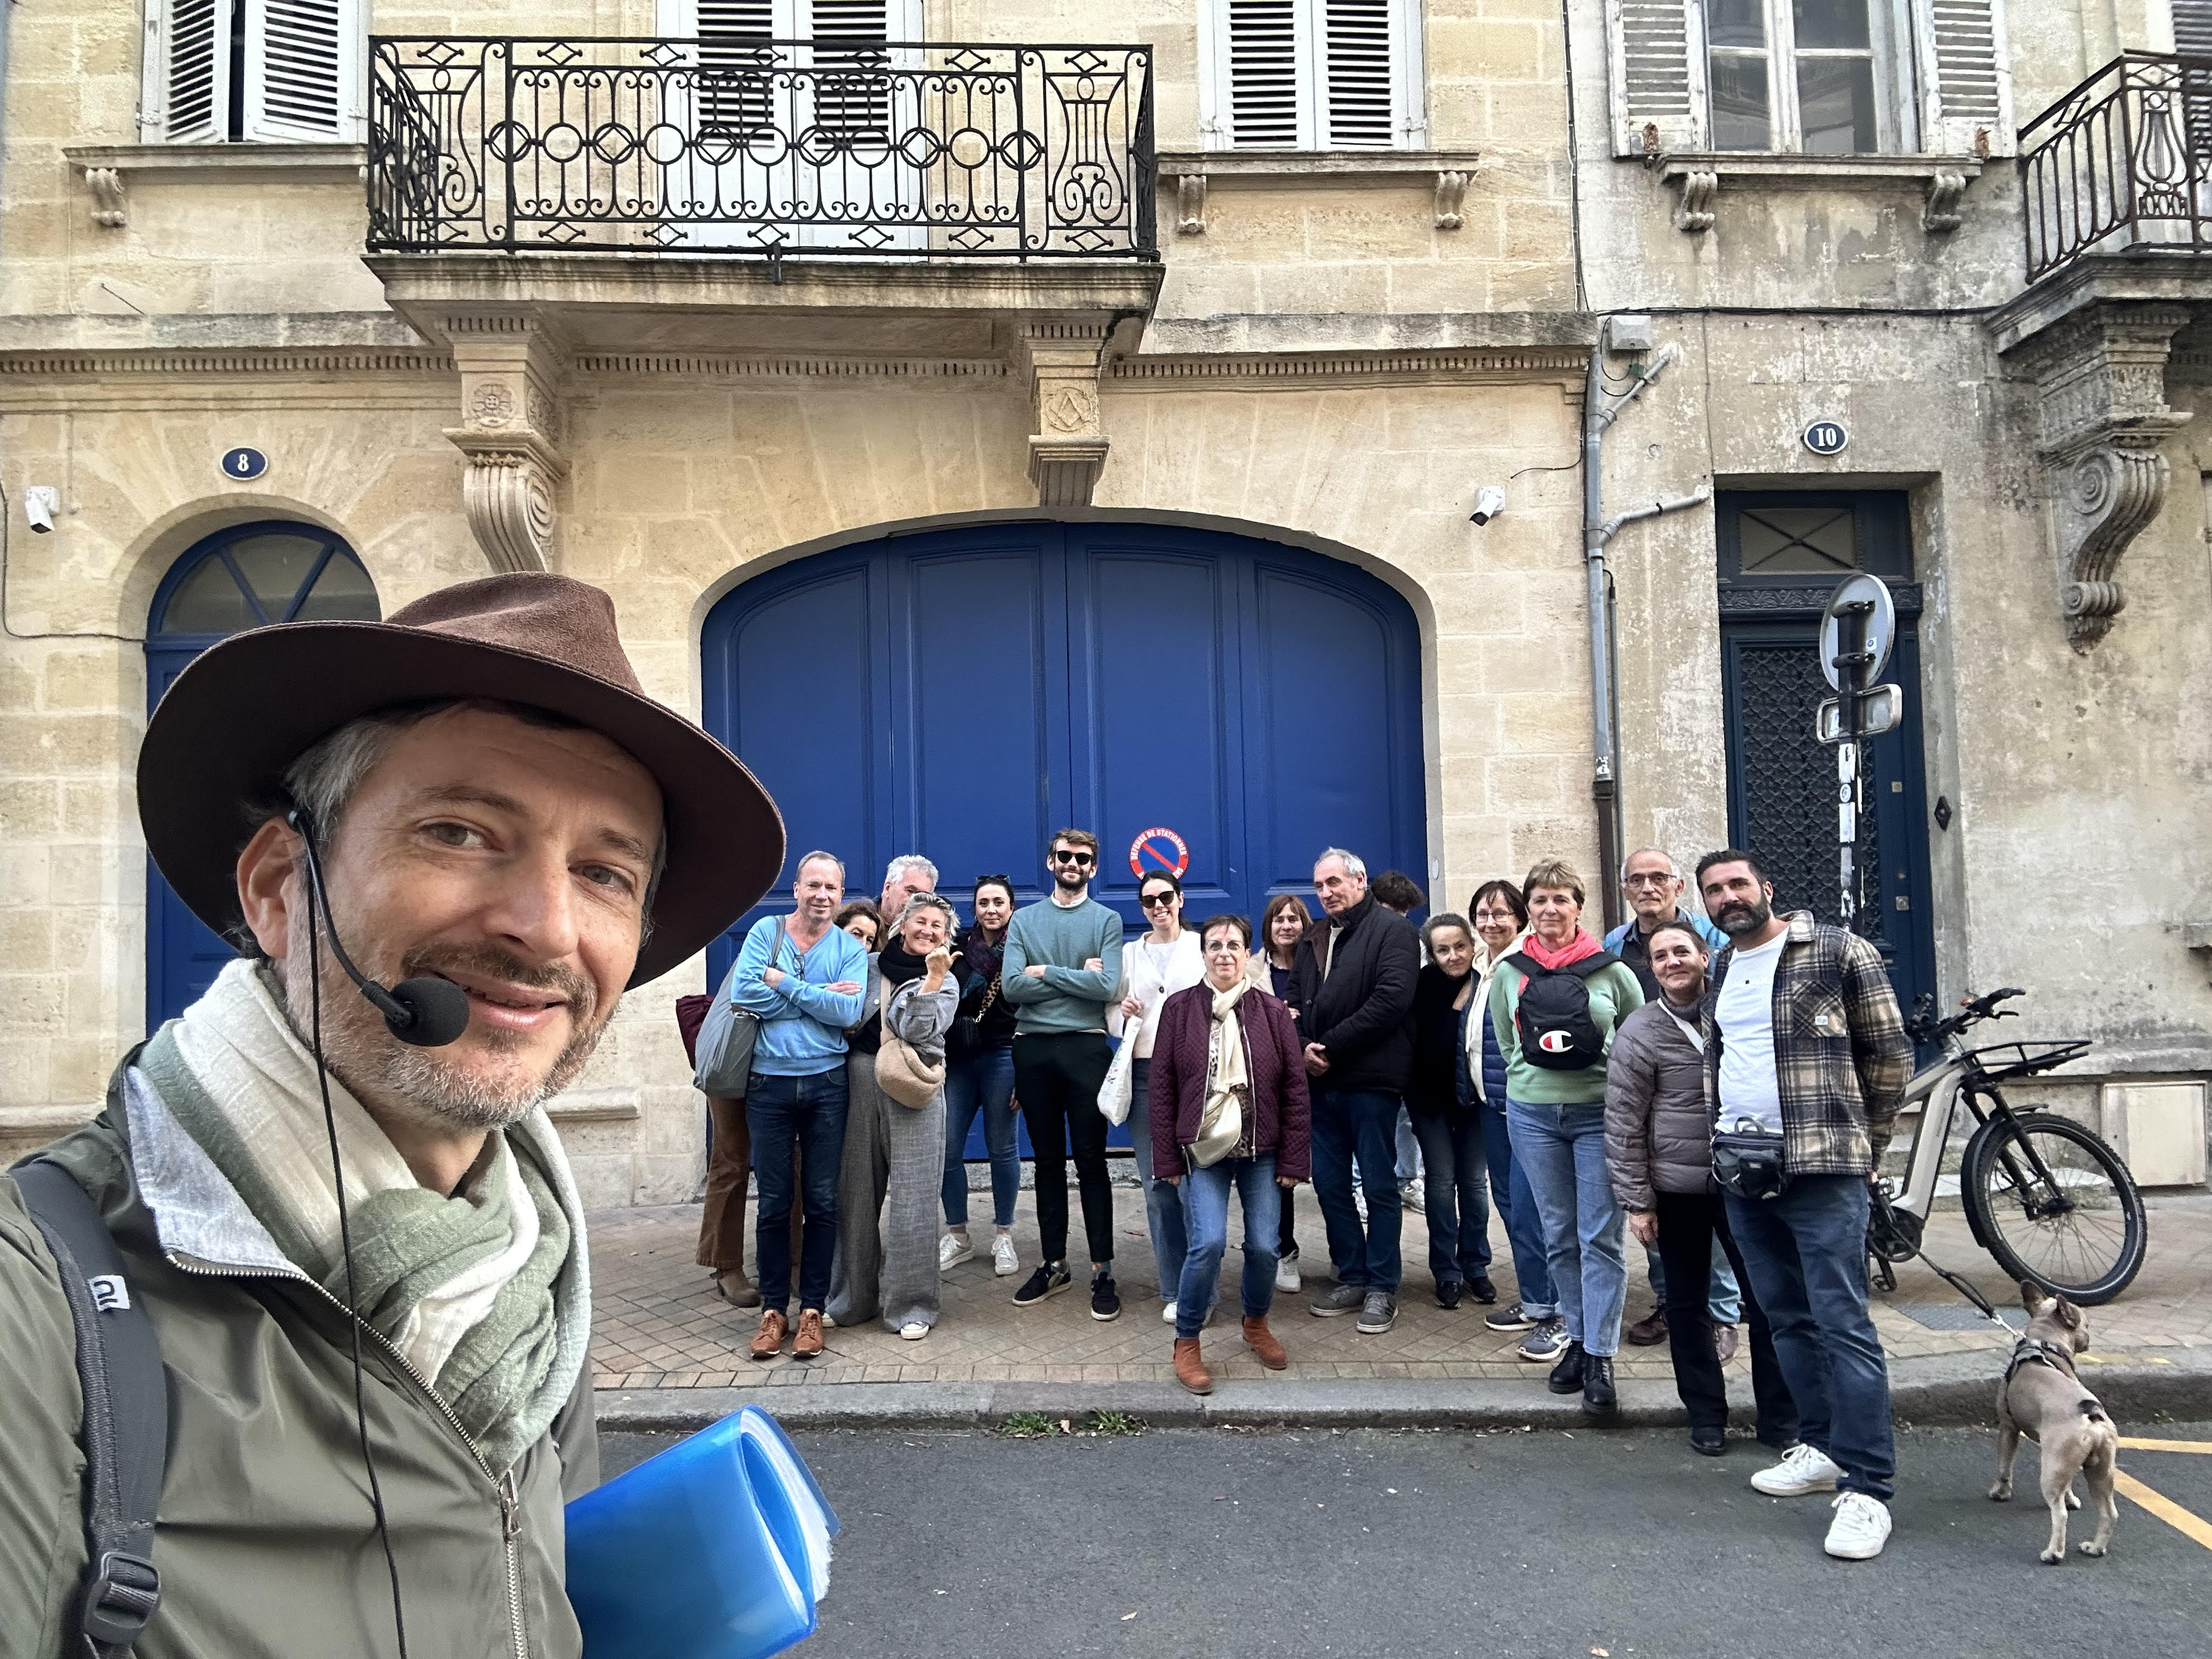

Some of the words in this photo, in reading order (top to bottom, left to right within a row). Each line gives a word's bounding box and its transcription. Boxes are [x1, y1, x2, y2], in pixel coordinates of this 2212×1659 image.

[1816, 428, 1837, 447] 10
[238, 454, 249, 472] 8
[1146, 829, 1156, 838] DE
[1156, 829, 1187, 856] STATIONNER
